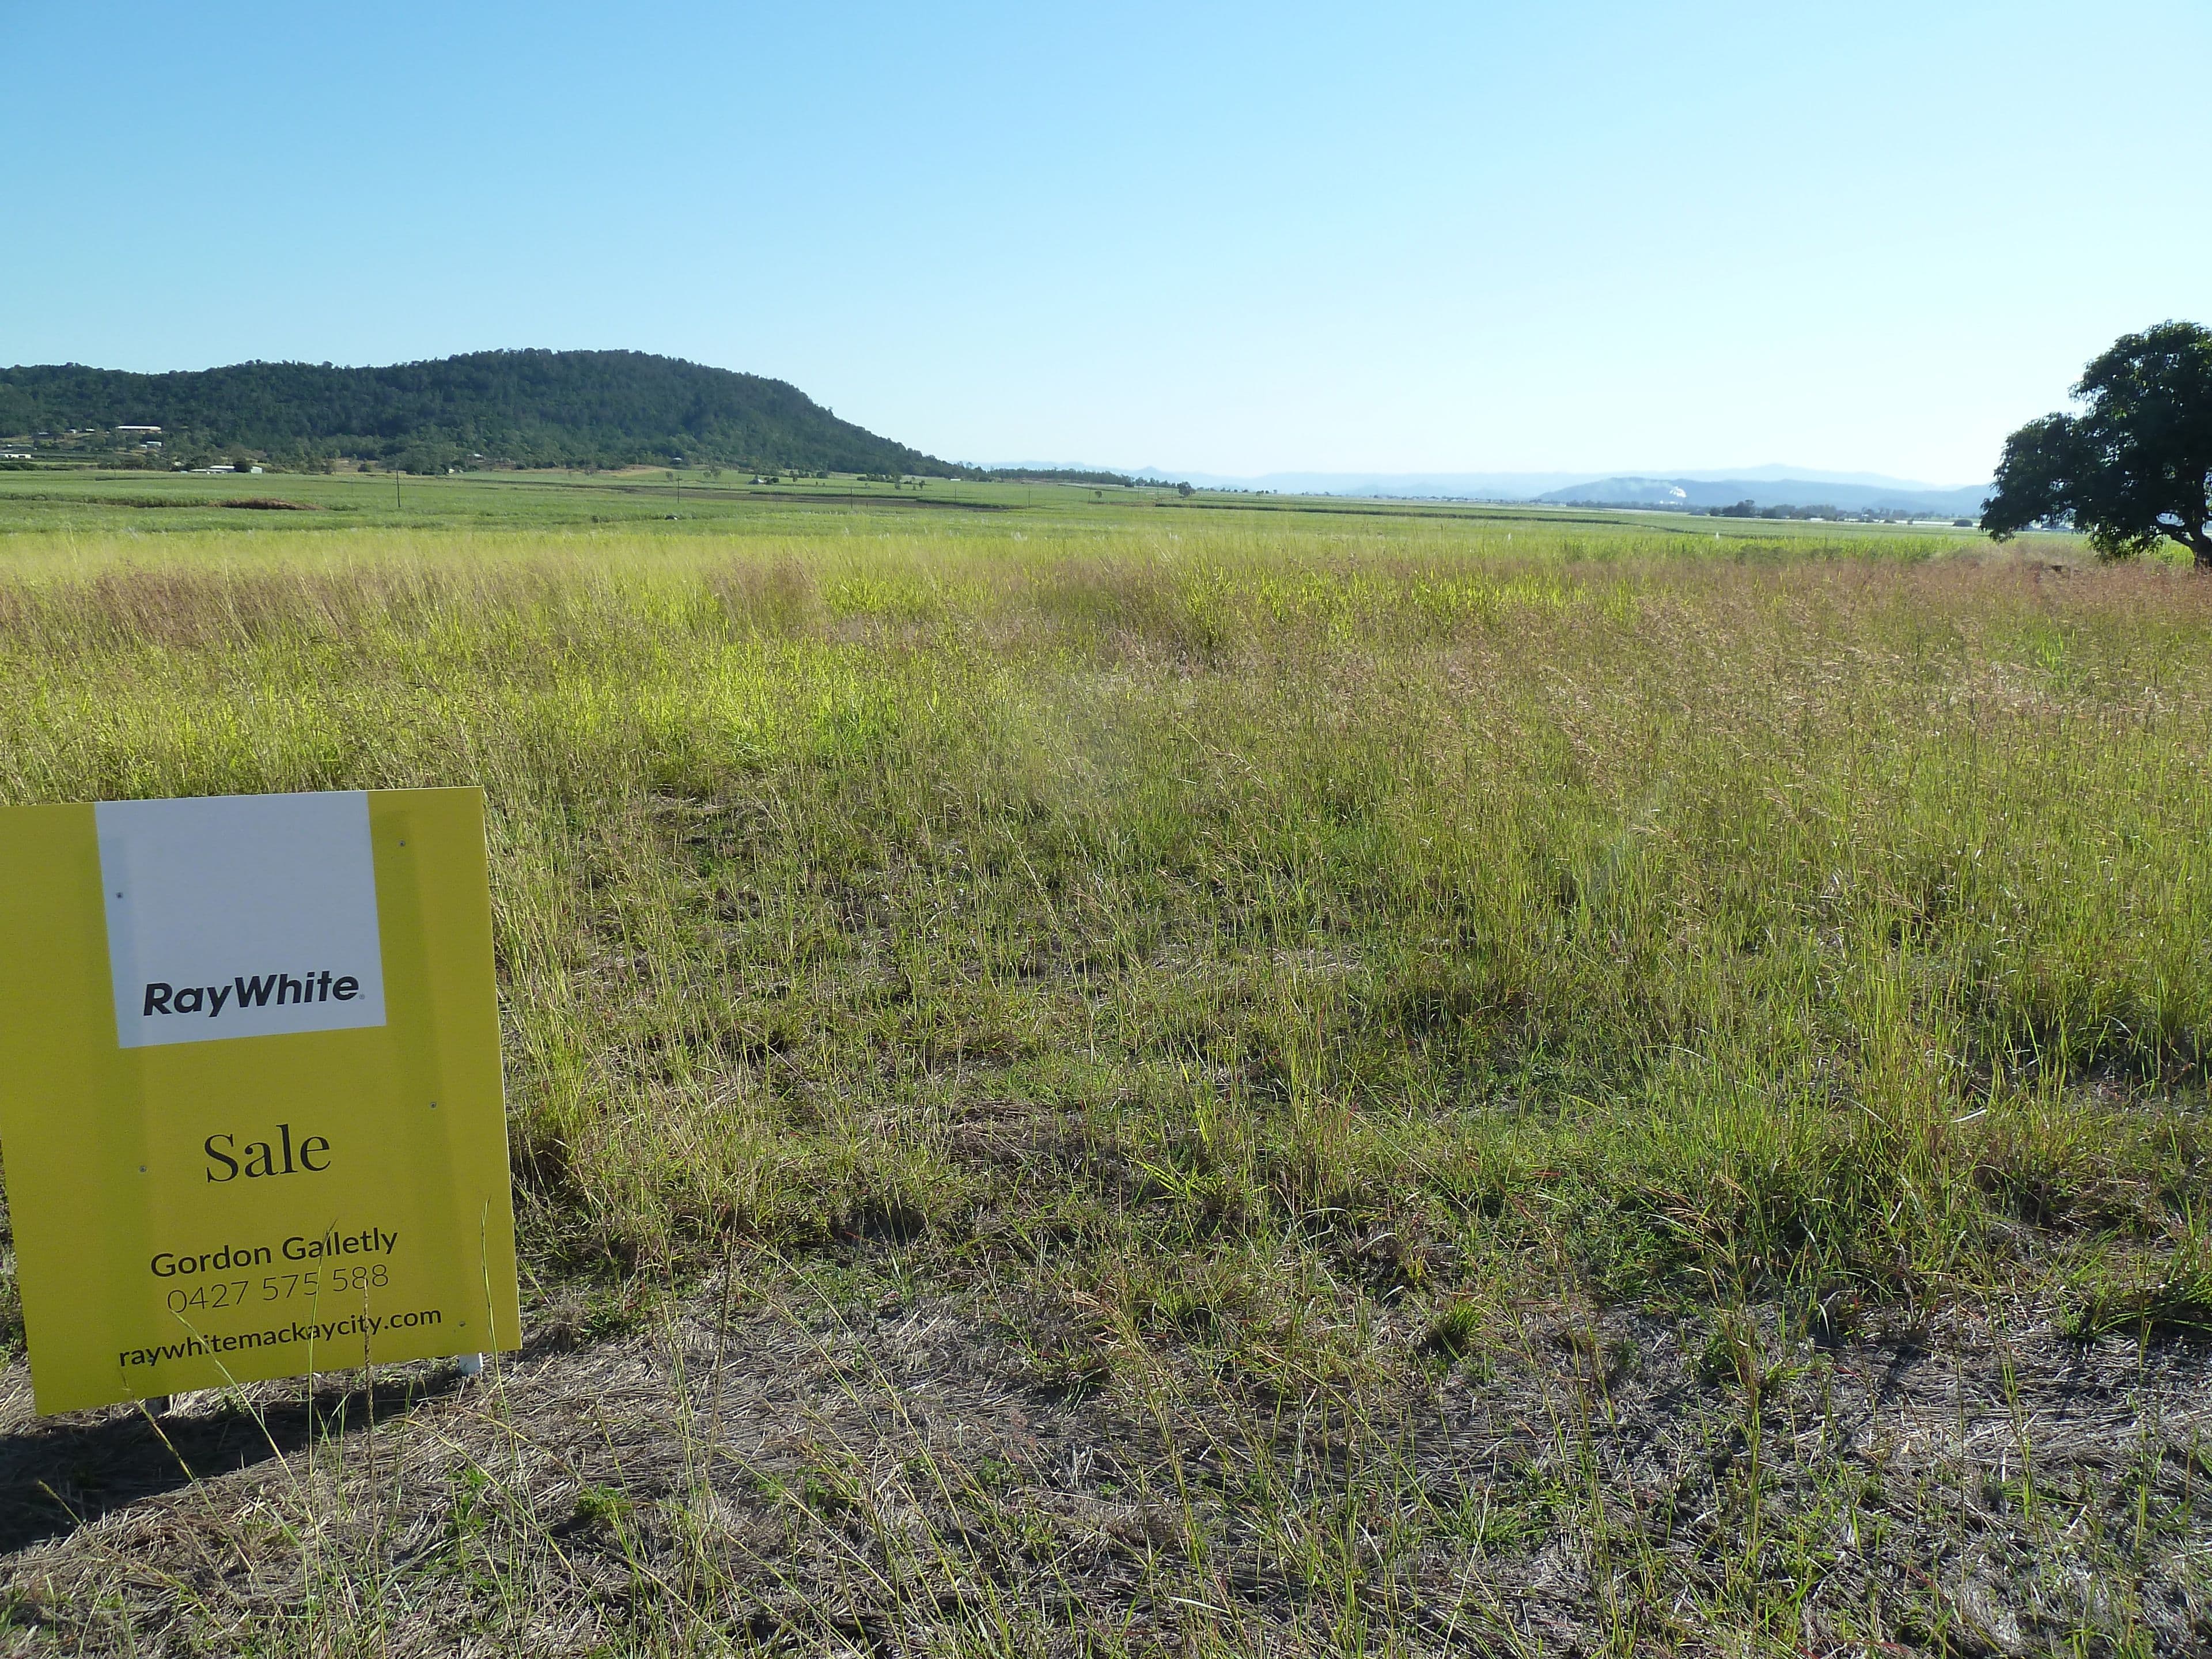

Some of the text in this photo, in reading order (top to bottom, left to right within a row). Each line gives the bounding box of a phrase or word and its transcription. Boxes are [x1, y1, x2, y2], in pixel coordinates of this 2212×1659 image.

[204, 1123, 332, 1183] Sale
[151, 1226, 399, 1278] Gordon Galletly
[167, 1264, 389, 1314] 0427 575 588
[119, 1309, 442, 1367] raywhitemackaycity.com
